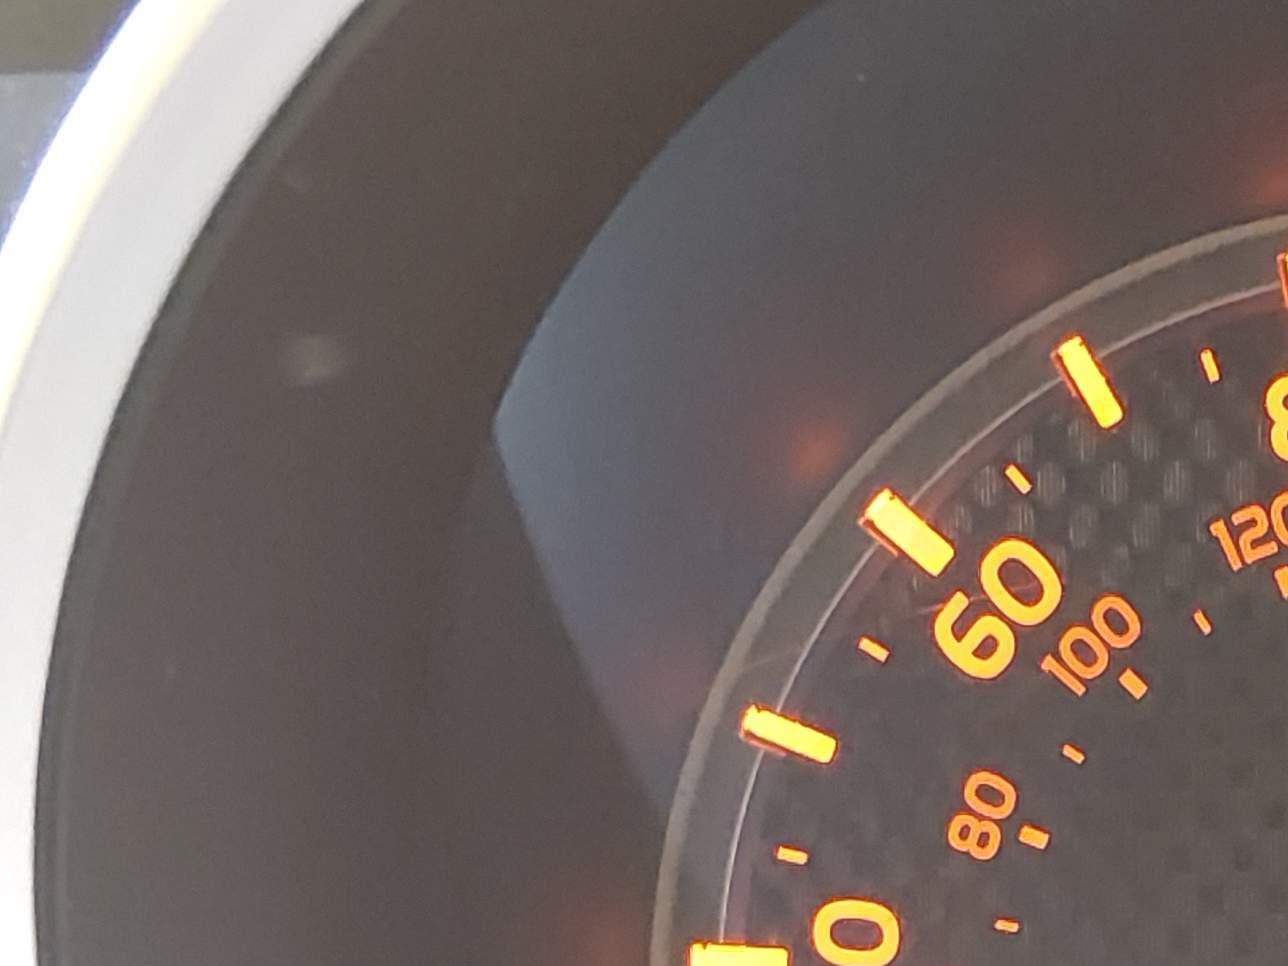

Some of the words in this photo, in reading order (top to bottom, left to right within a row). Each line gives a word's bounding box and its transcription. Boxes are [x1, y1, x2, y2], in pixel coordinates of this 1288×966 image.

[933, 537, 1064, 681] 60
[1041, 593, 1143, 697] 100
[946, 769, 1018, 860] 80
